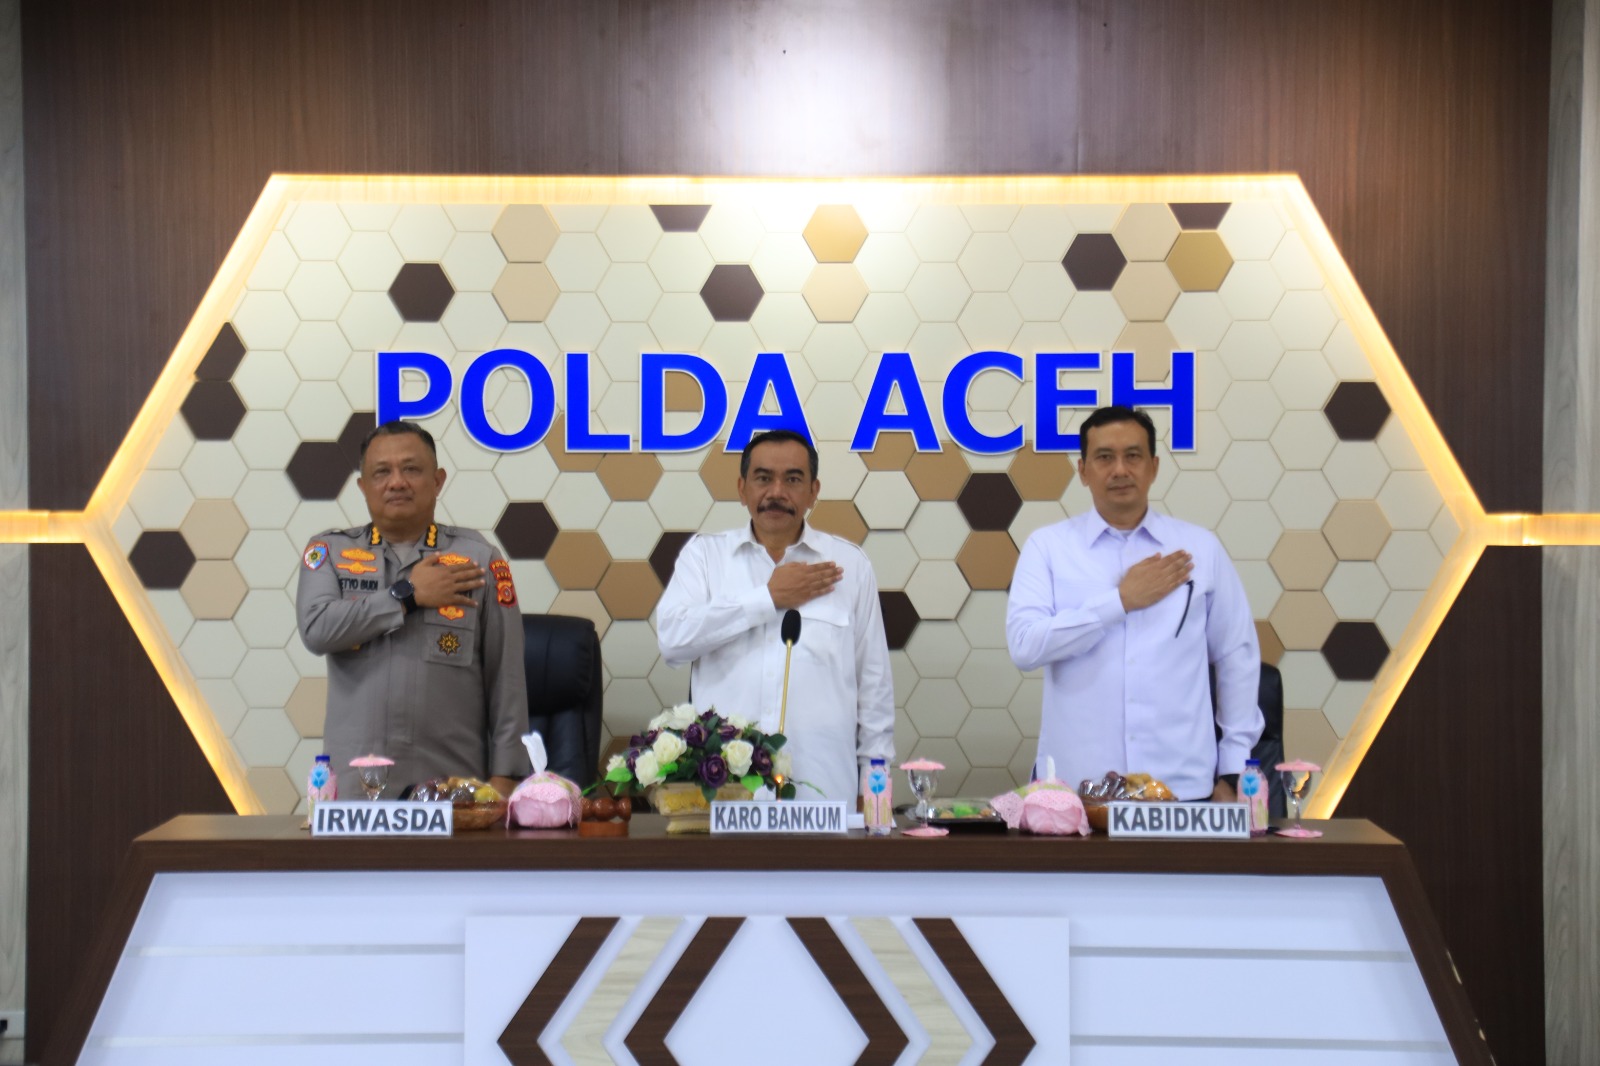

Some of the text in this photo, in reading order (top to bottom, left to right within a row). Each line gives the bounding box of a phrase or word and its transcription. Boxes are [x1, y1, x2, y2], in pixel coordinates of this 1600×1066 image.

[377, 349, 1194, 453] POLDA ACEH
[340, 578, 379, 591] ETYO BUDI
[317, 808, 447, 832] IRWASDA
[714, 806, 841, 830] KARO BANKUM
[1112, 807, 1246, 831] KABIDKUM
